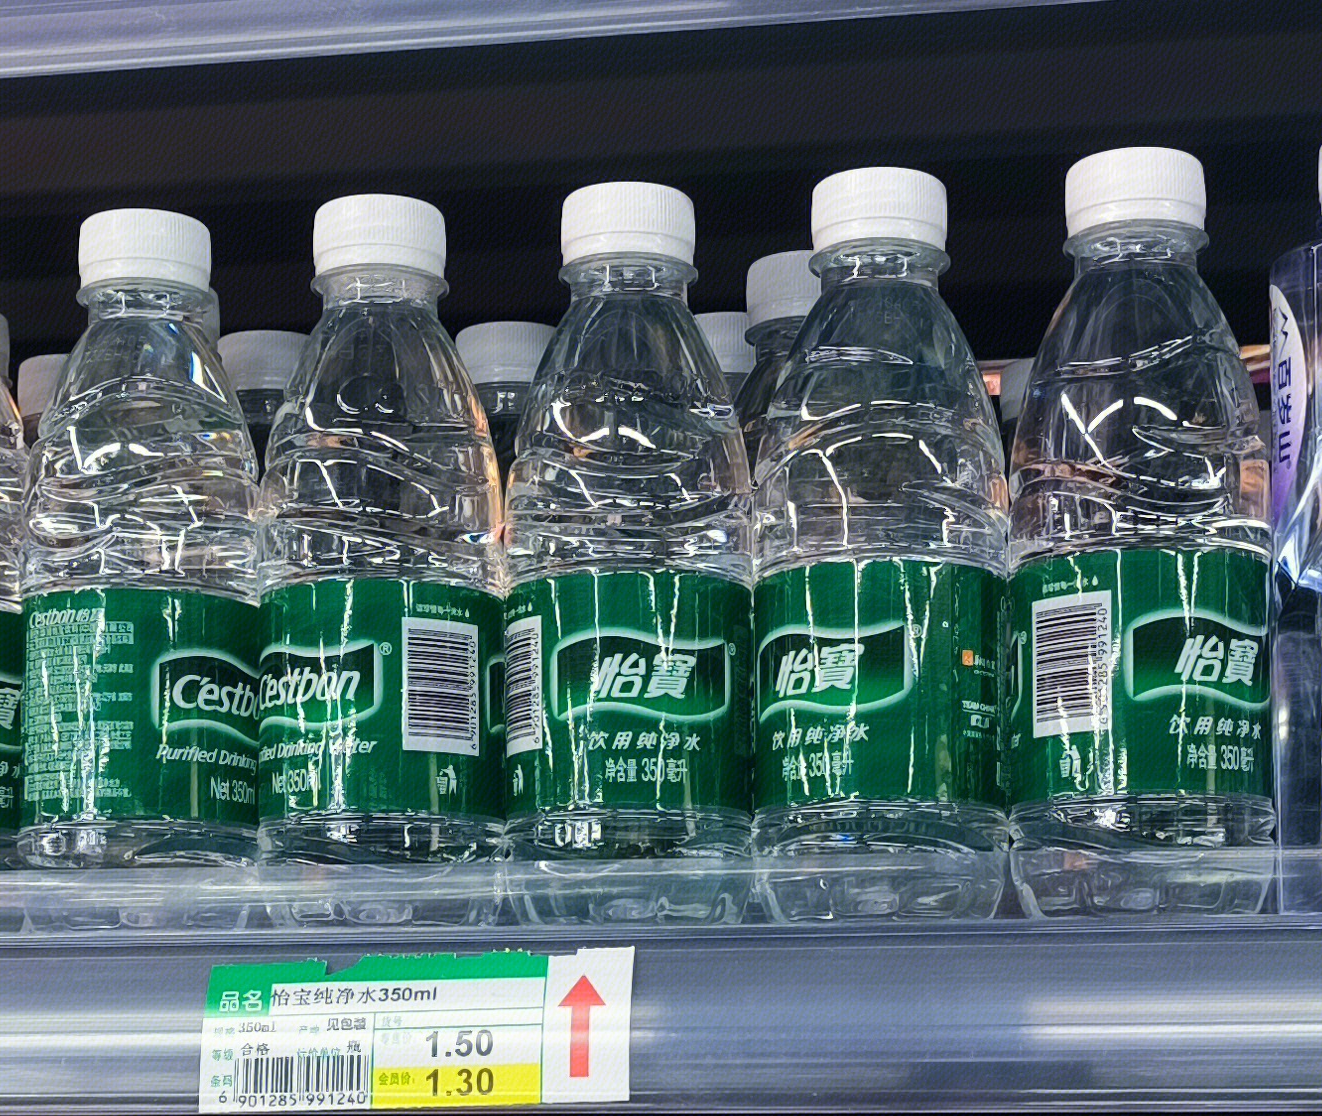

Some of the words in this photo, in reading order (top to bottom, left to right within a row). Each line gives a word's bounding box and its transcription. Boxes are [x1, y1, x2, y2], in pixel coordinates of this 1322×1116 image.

[776, 641, 865, 698] 怡寶
[1174, 634, 1259, 687] 怡寶
[594, 651, 697, 700] 怡寶
[772, 723, 870, 751] 饮用纯净水
[1169, 714, 1262, 740] 饮用纯净水
[589, 731, 701, 753] 饮用纯净水
[210, 775, 230, 800] Net
[218, 989, 265, 1012] 品名
[270, 985, 438, 1006] 怡宝纯净水350ml
[326, 1017, 367, 1032] 见包装
[240, 1043, 271, 1057] 合格
[425, 1029, 494, 1058] 1.50
[425, 1067, 495, 1097] 1.30
[238, 1093, 297, 1108] 901285
[305, 1090, 367, 1106] 991240
